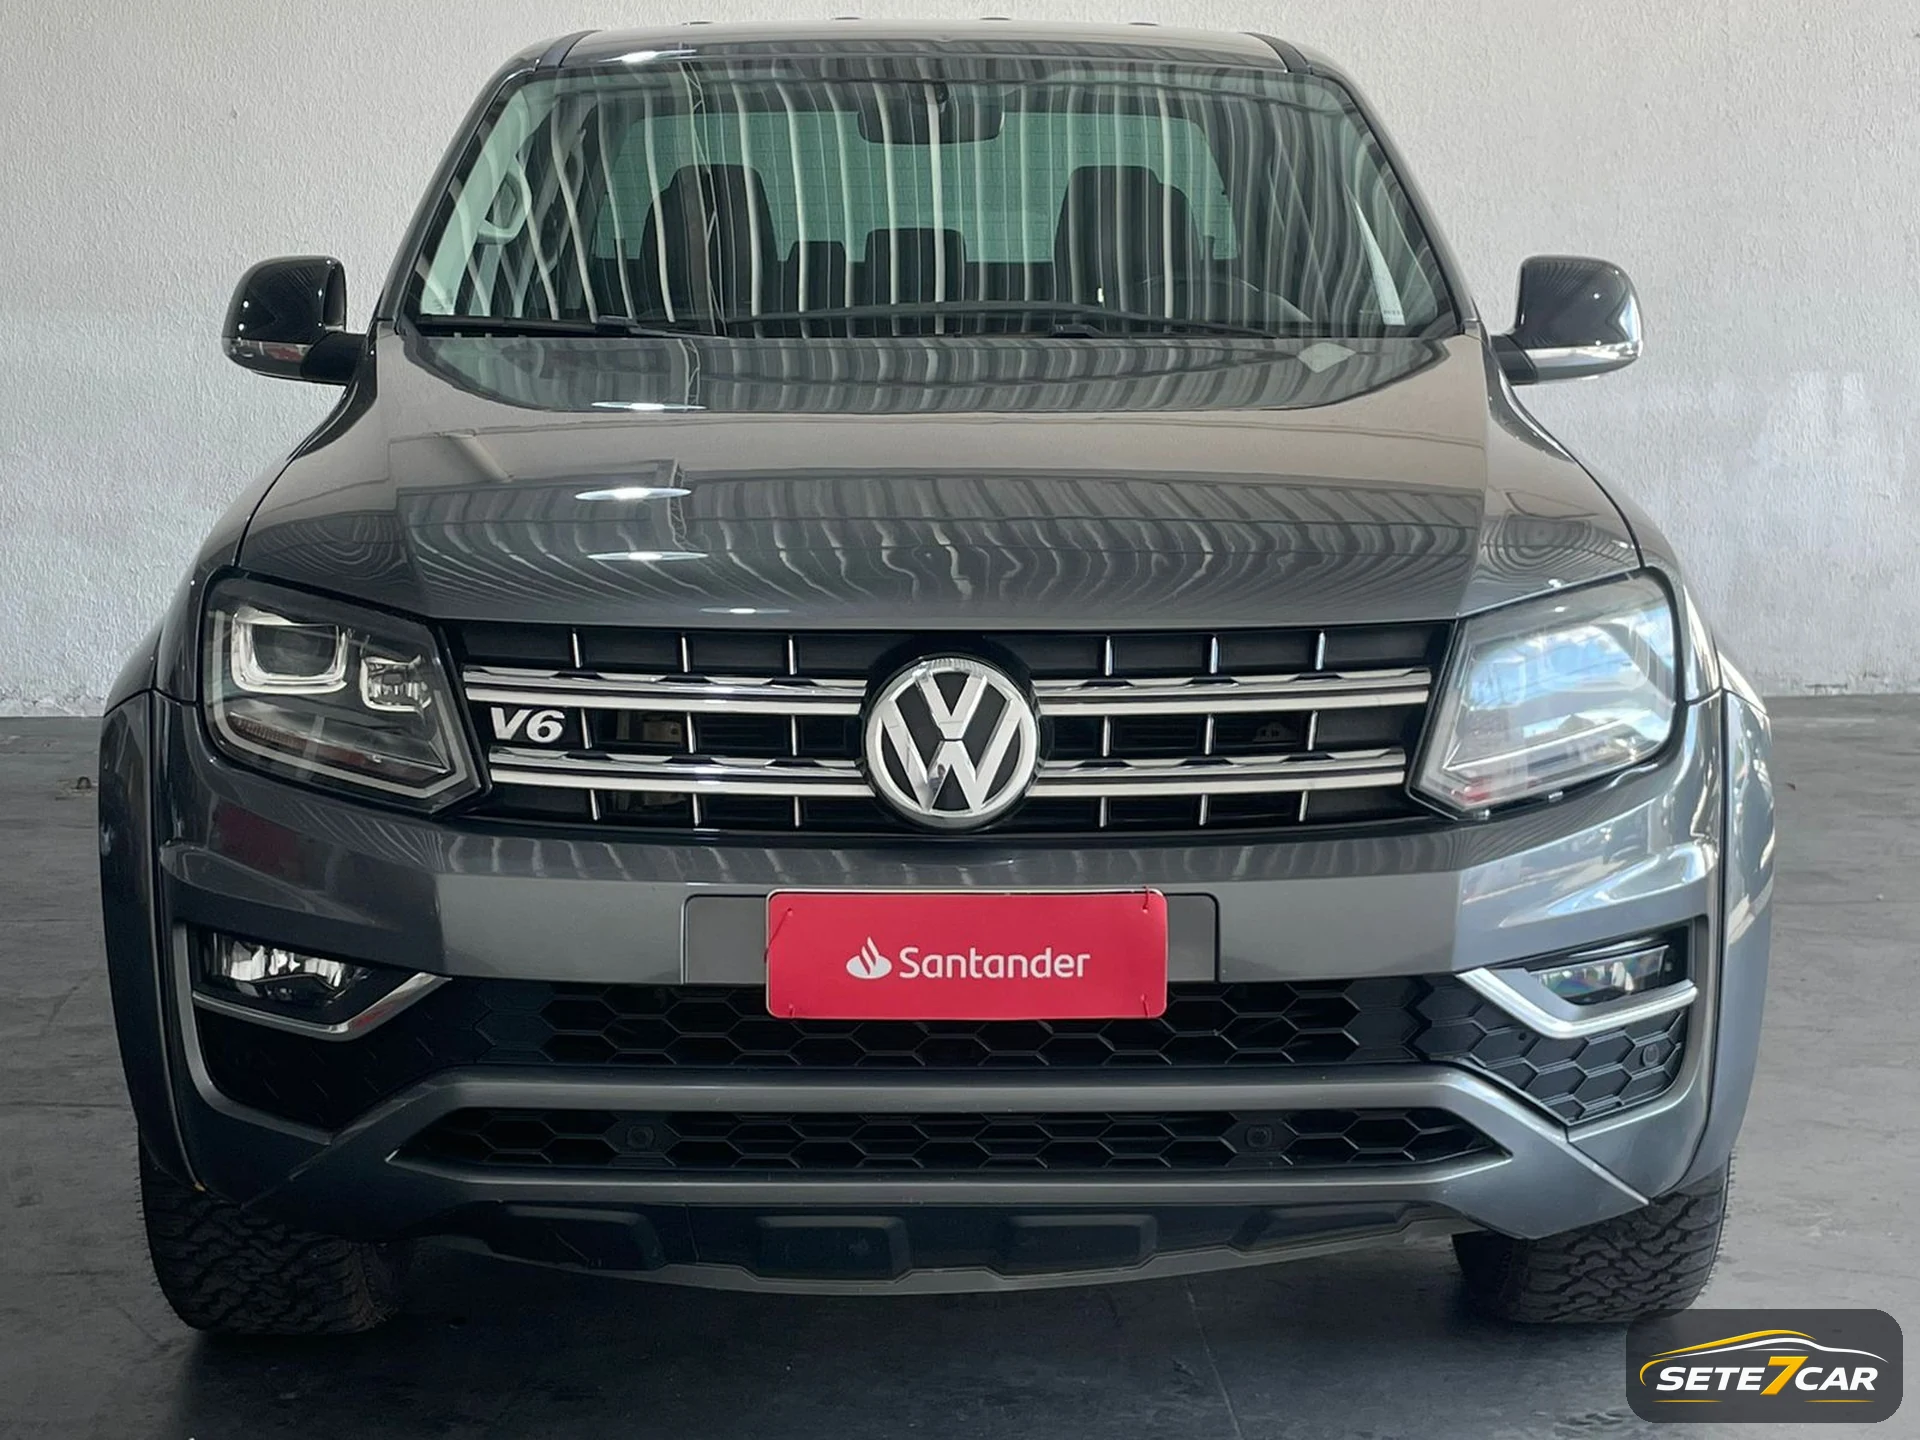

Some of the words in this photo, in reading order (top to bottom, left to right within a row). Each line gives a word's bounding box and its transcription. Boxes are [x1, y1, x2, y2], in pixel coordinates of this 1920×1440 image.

[490, 706, 565, 743] V6
[873, 665, 1030, 819] VW
[899, 947, 1091, 980] Santander
